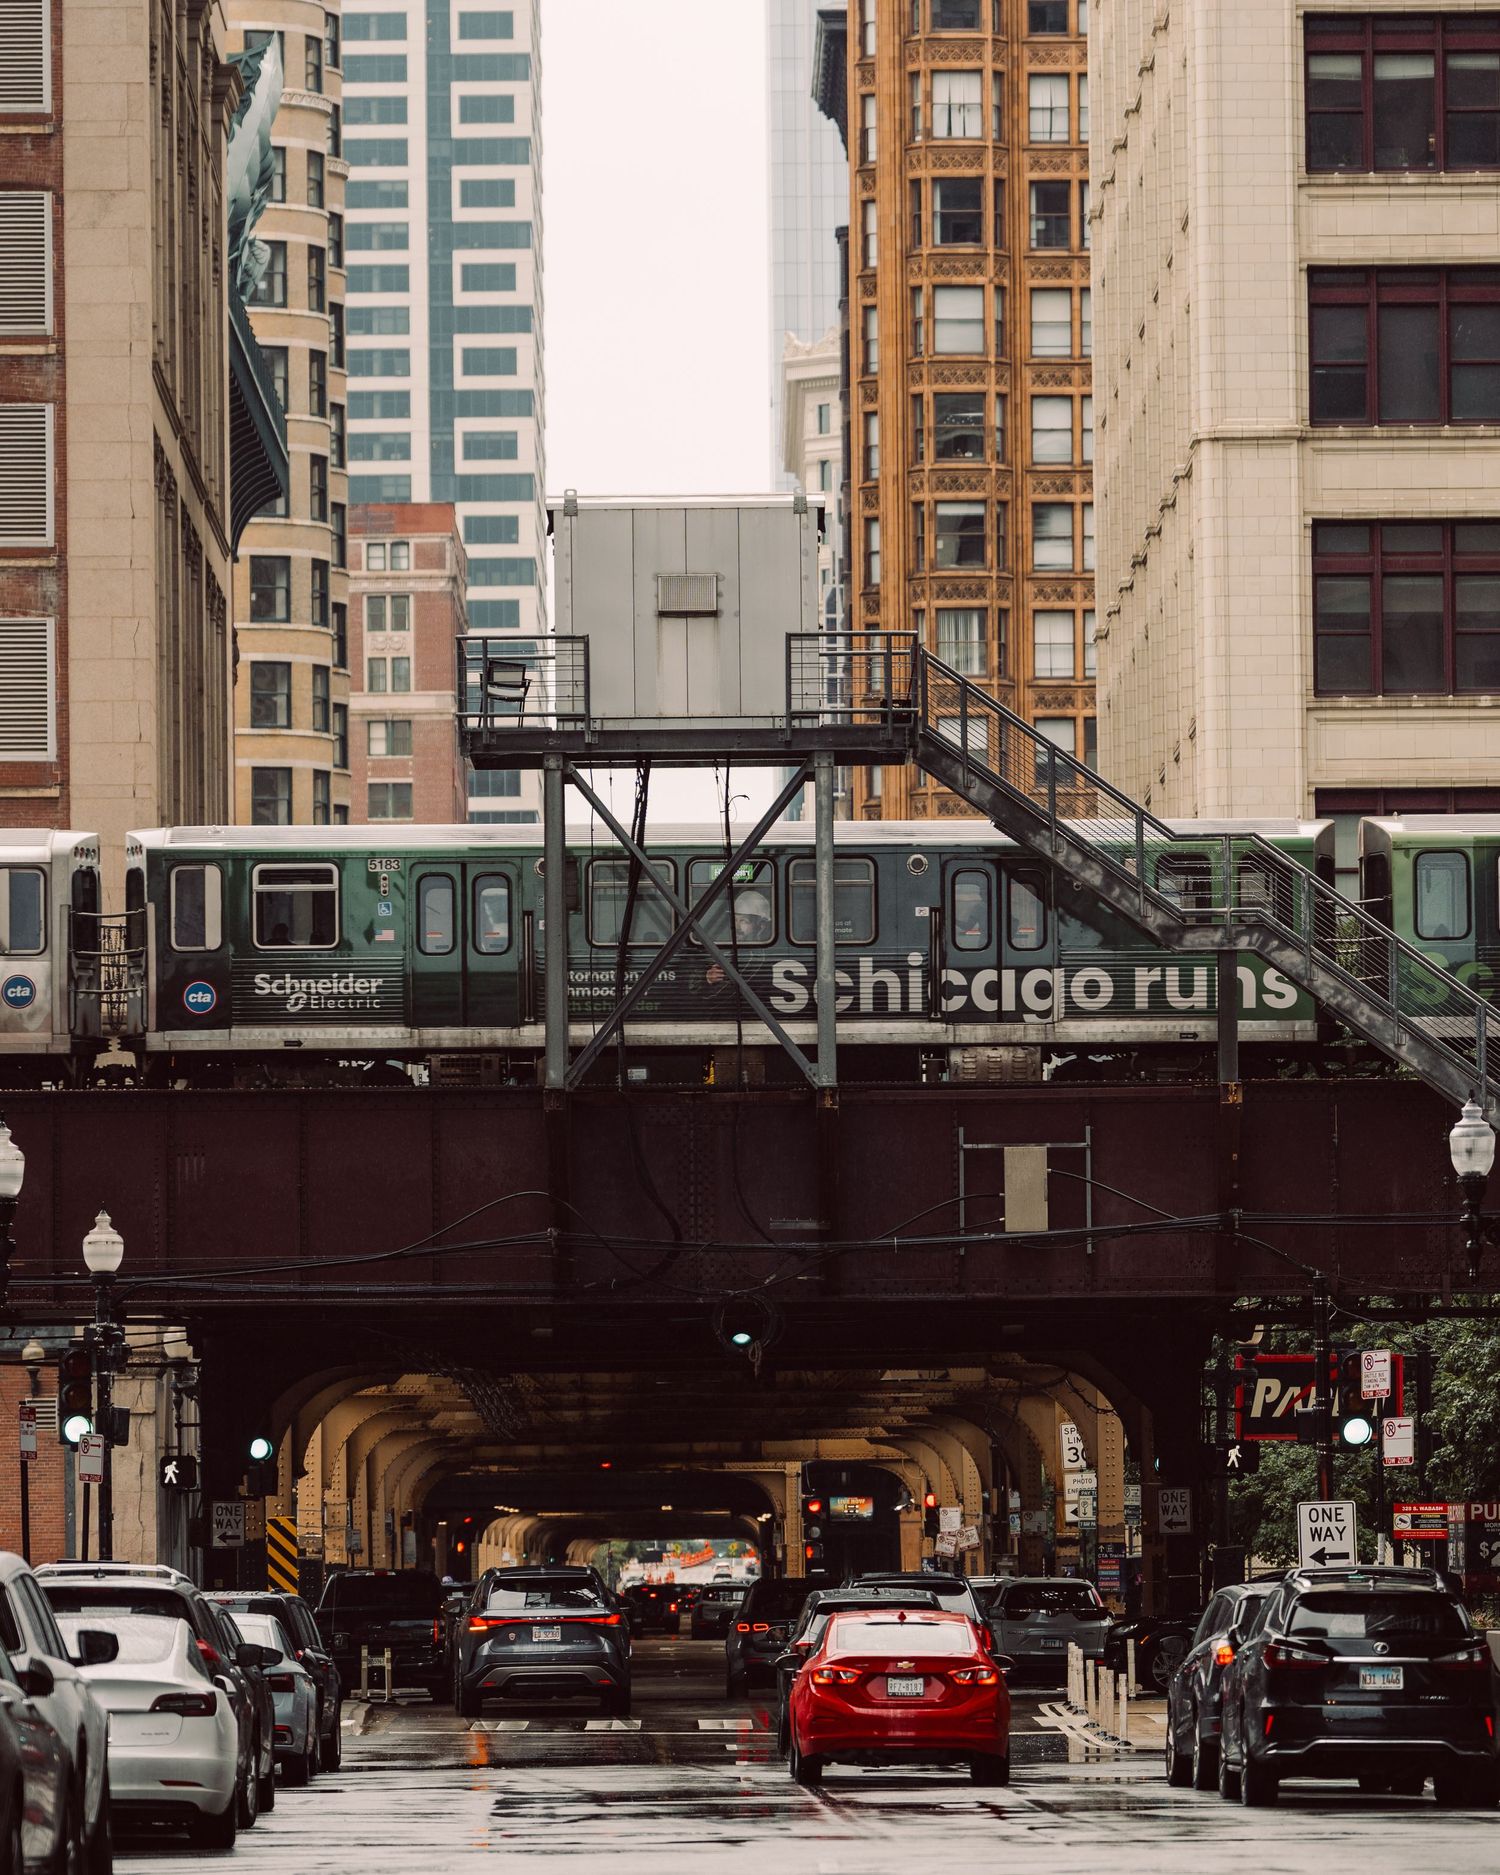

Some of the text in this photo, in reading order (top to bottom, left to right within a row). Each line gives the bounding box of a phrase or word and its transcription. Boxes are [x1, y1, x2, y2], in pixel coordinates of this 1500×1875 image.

[369, 859, 400, 870] 5183
[254, 973, 383, 995] Schneider
[1134, 966, 1298, 1010] runs
[7, 986, 30, 998] cta
[188, 991, 211, 1003] cta
[311, 995, 381, 1009] Electric
[1161, 1491, 1187, 1503] ONE
[215, 1505, 241, 1516] ONE
[1161, 1504, 1187, 1516] WAY
[1308, 1507, 1344, 1523] ONE
[1471, 1503, 1500, 1520] PU
[215, 1518, 241, 1529] WAY
[1310, 1525, 1347, 1542] WAY
